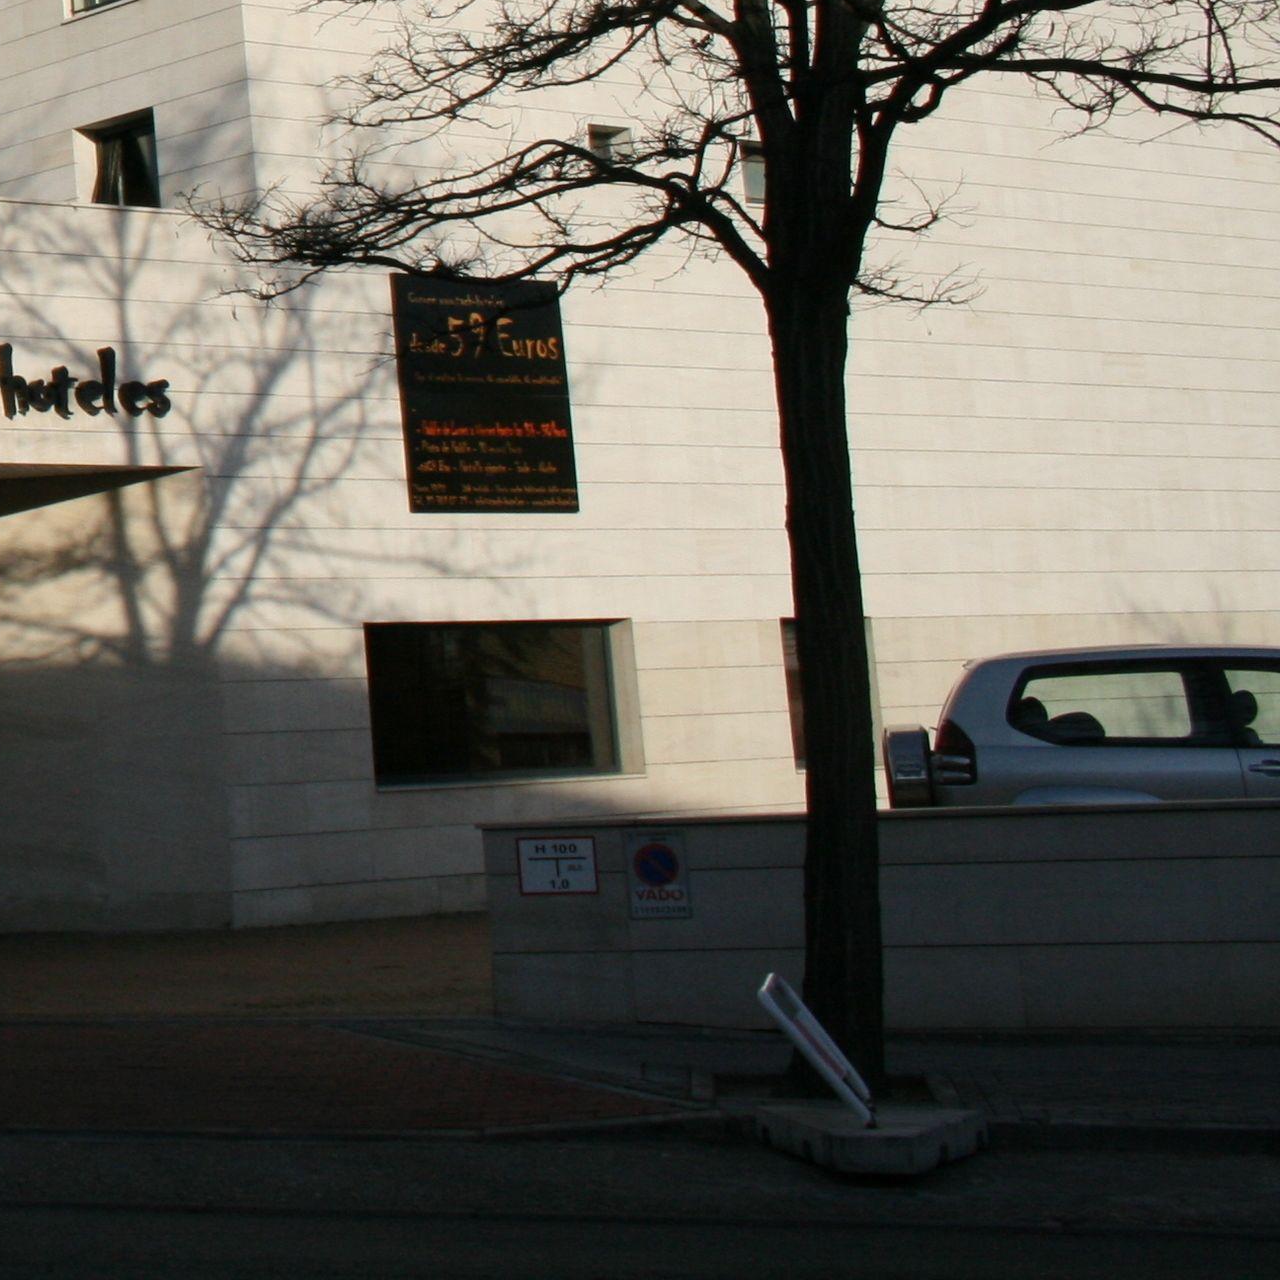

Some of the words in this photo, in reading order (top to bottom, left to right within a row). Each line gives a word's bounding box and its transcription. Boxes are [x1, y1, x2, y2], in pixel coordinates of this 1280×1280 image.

[496, 317, 559, 360] Euros
[535, 844, 545, 853] H
[551, 843, 577, 853] 100
[635, 888, 684, 900] VADO
